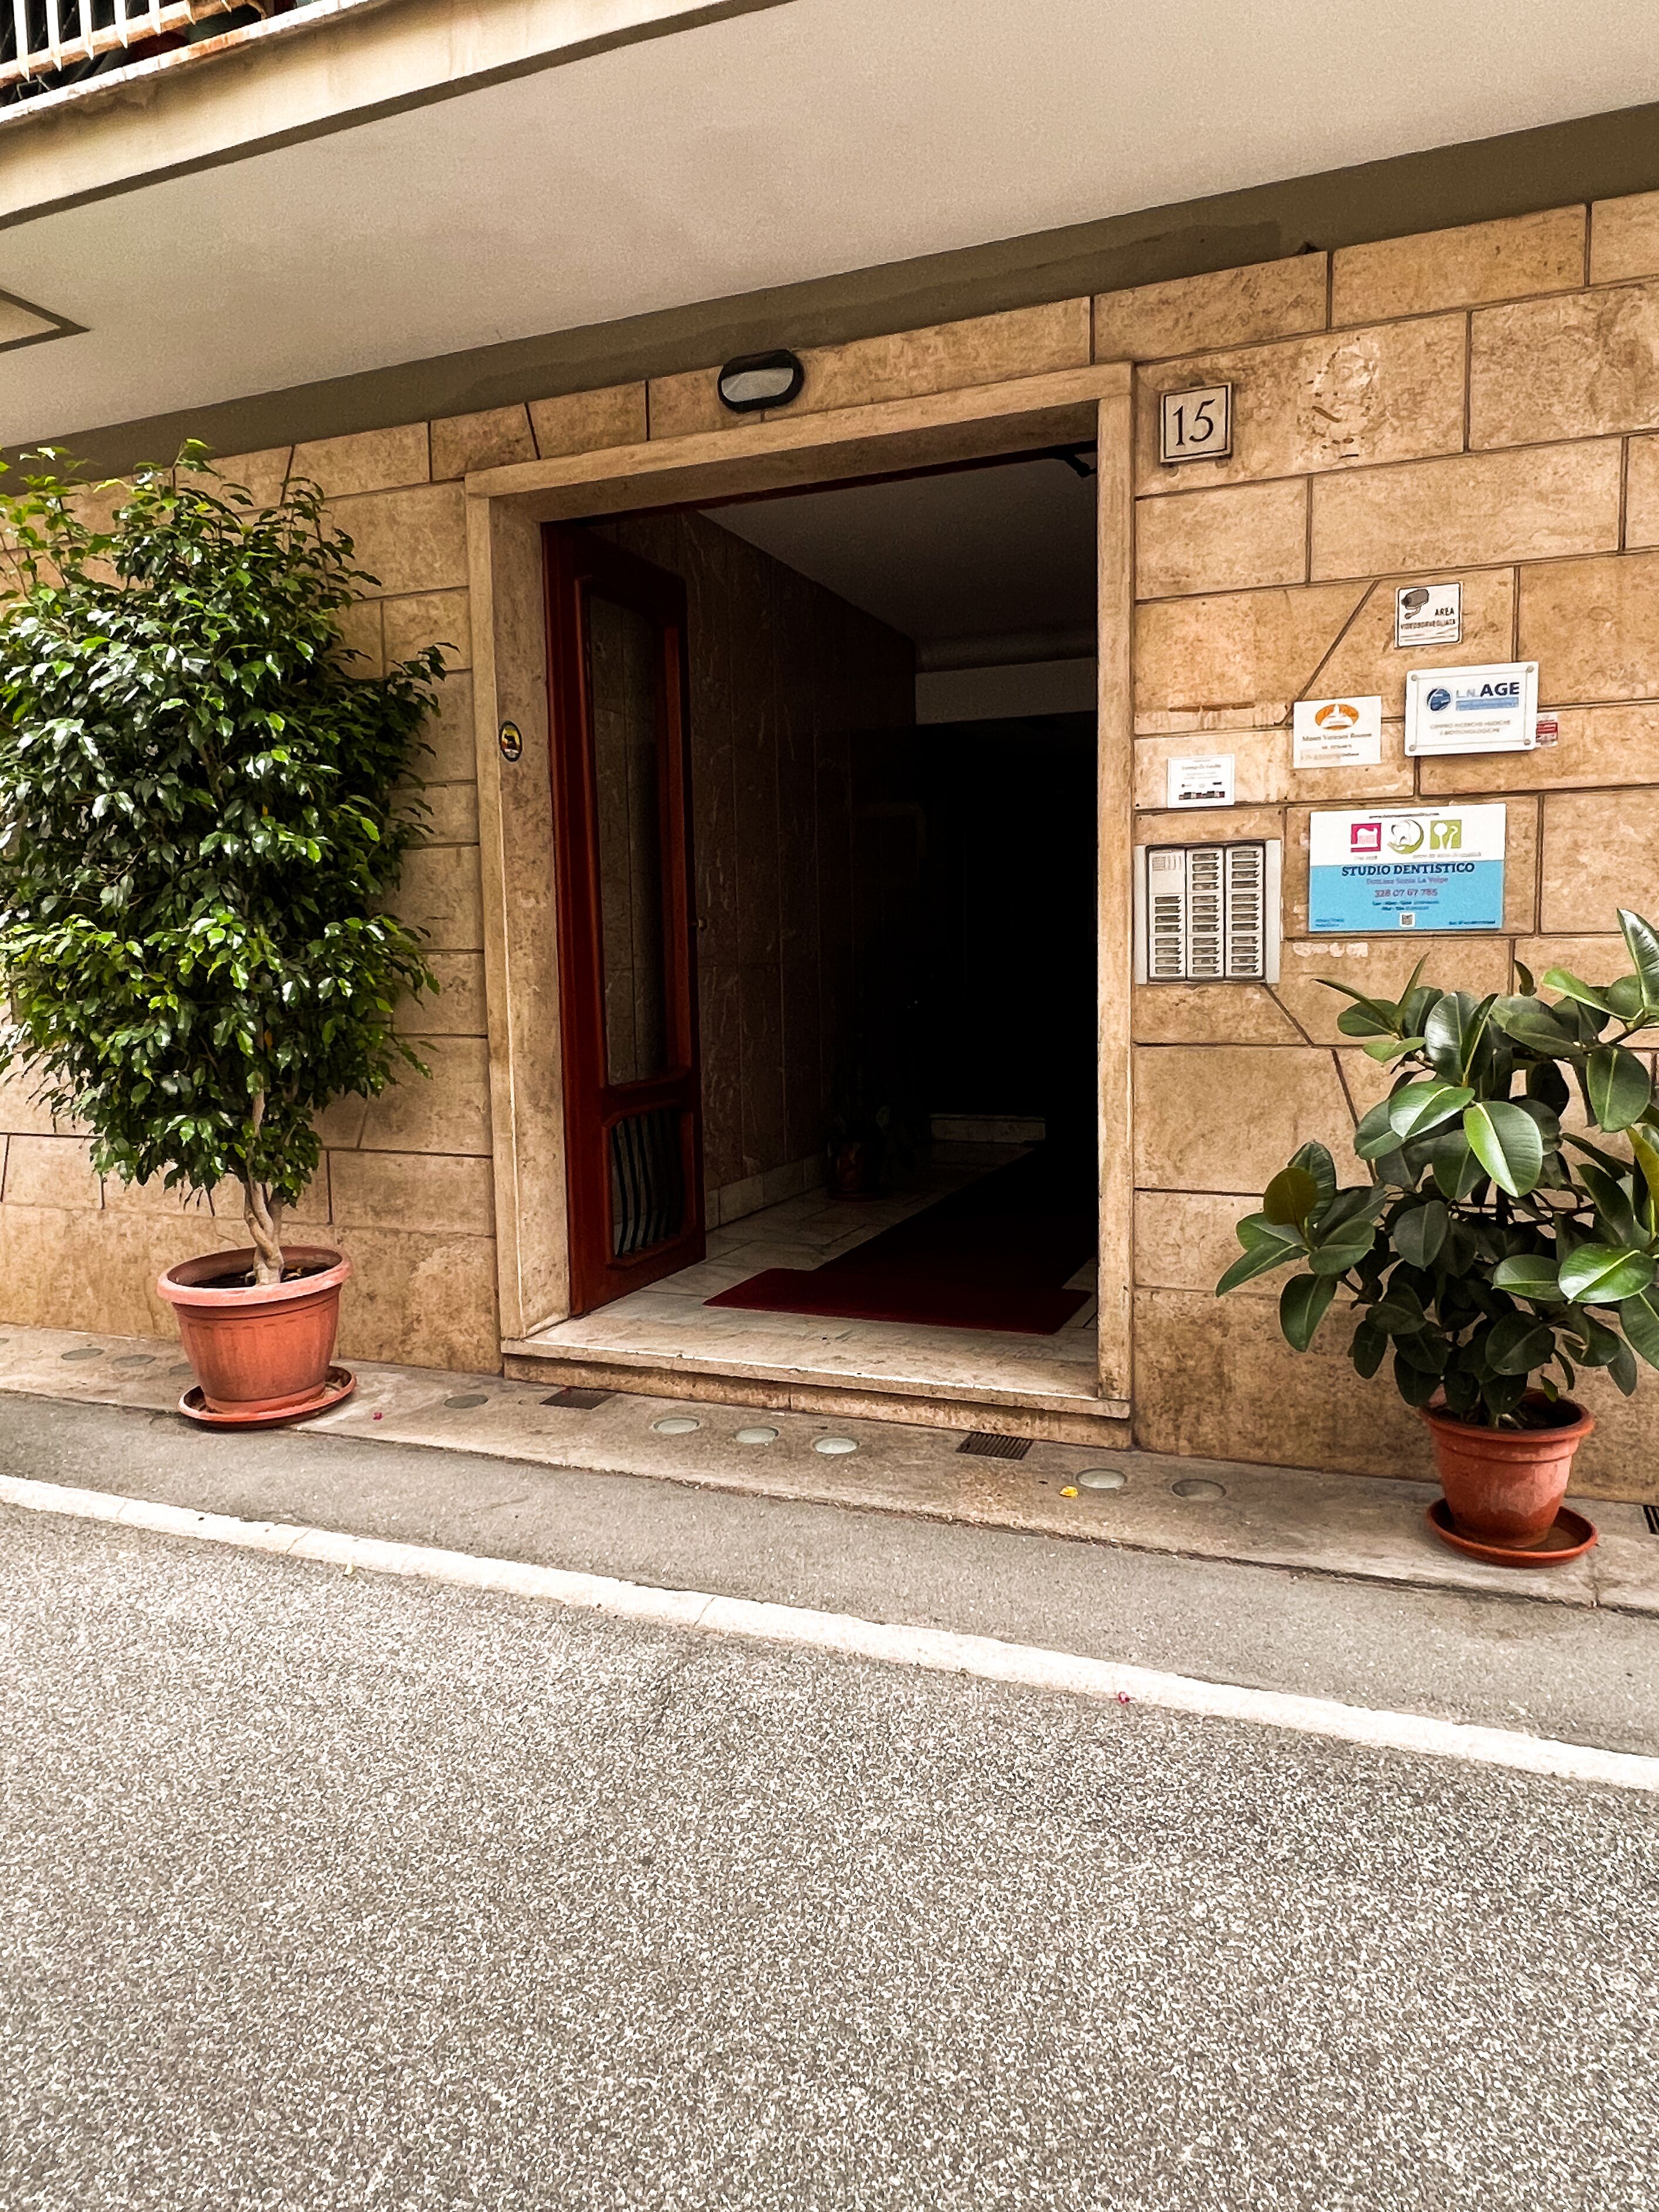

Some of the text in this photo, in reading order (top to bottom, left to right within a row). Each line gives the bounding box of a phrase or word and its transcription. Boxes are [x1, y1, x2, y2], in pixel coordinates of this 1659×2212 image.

[1173, 399, 1215, 446] 15
[1435, 607, 1455, 616] AREA
[1341, 862, 1475, 876] STUDIO DENTISTICO
